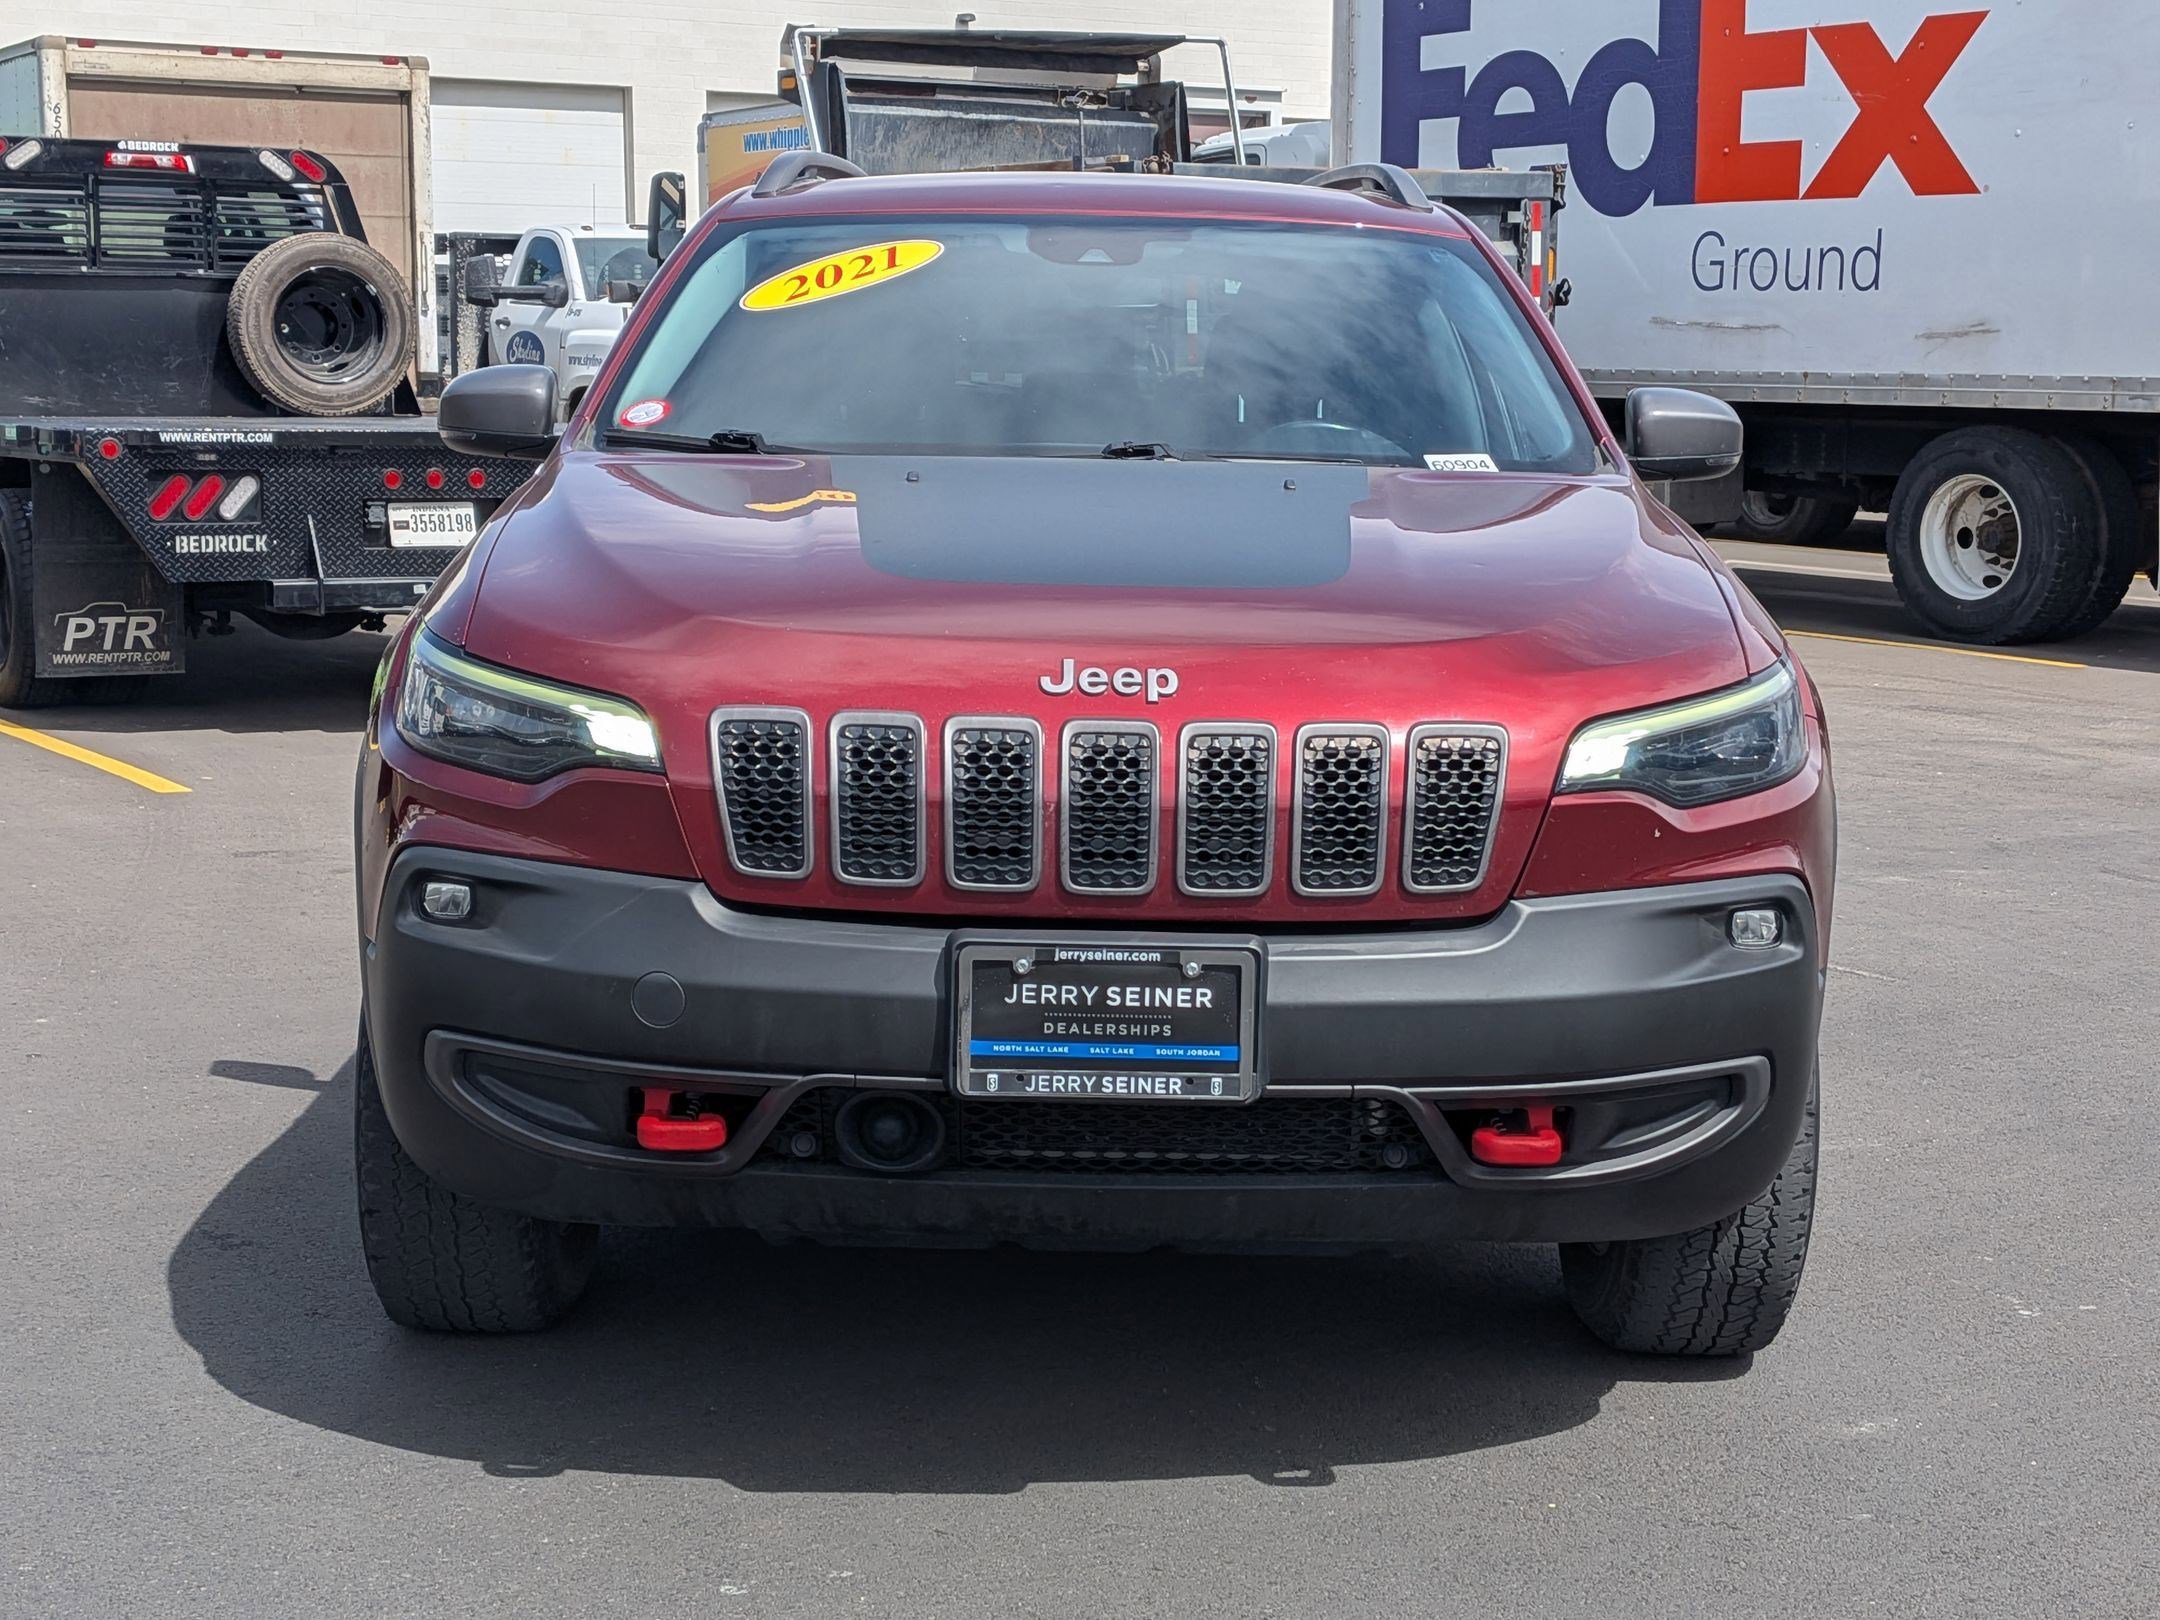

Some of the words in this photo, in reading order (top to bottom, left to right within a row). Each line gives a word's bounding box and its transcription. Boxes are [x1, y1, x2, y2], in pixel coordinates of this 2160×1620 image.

[1380, 0, 1991, 217] FedEx
[127, 140, 179, 152] BEDROCK
[1691, 228, 1882, 292] Ground
[783, 246, 903, 302] 2021
[159, 432, 272, 443] WWW.RENTPTR.COM
[1431, 459, 1490, 471] 60904
[410, 513, 473, 533] 3558198
[175, 534, 268, 553] BEDROCK
[63, 616, 157, 652] PTR
[52, 650, 171, 665] WWW.RENTPTR.COM
[1039, 658, 1179, 704] Jeep
[1054, 948, 1161, 963] jerryseiner.com
[1004, 983, 1099, 1006] JERRY
[1106, 985, 1213, 1008] SEINER
[1043, 1022, 1172, 1036] DEALERSHIPS
[993, 1044, 1022, 1052] NORTH
[1024, 1045, 1045, 1053] SALT
[1047, 1046, 1069, 1054] LAKE
[1112, 1047, 1135, 1055] LAKE
[1155, 1048, 1184, 1056] SOUTH
[1186, 1049, 1221, 1057] JORDAN
[1025, 1075, 1096, 1093] JERRY
[1101, 1076, 1182, 1095] SEINER
